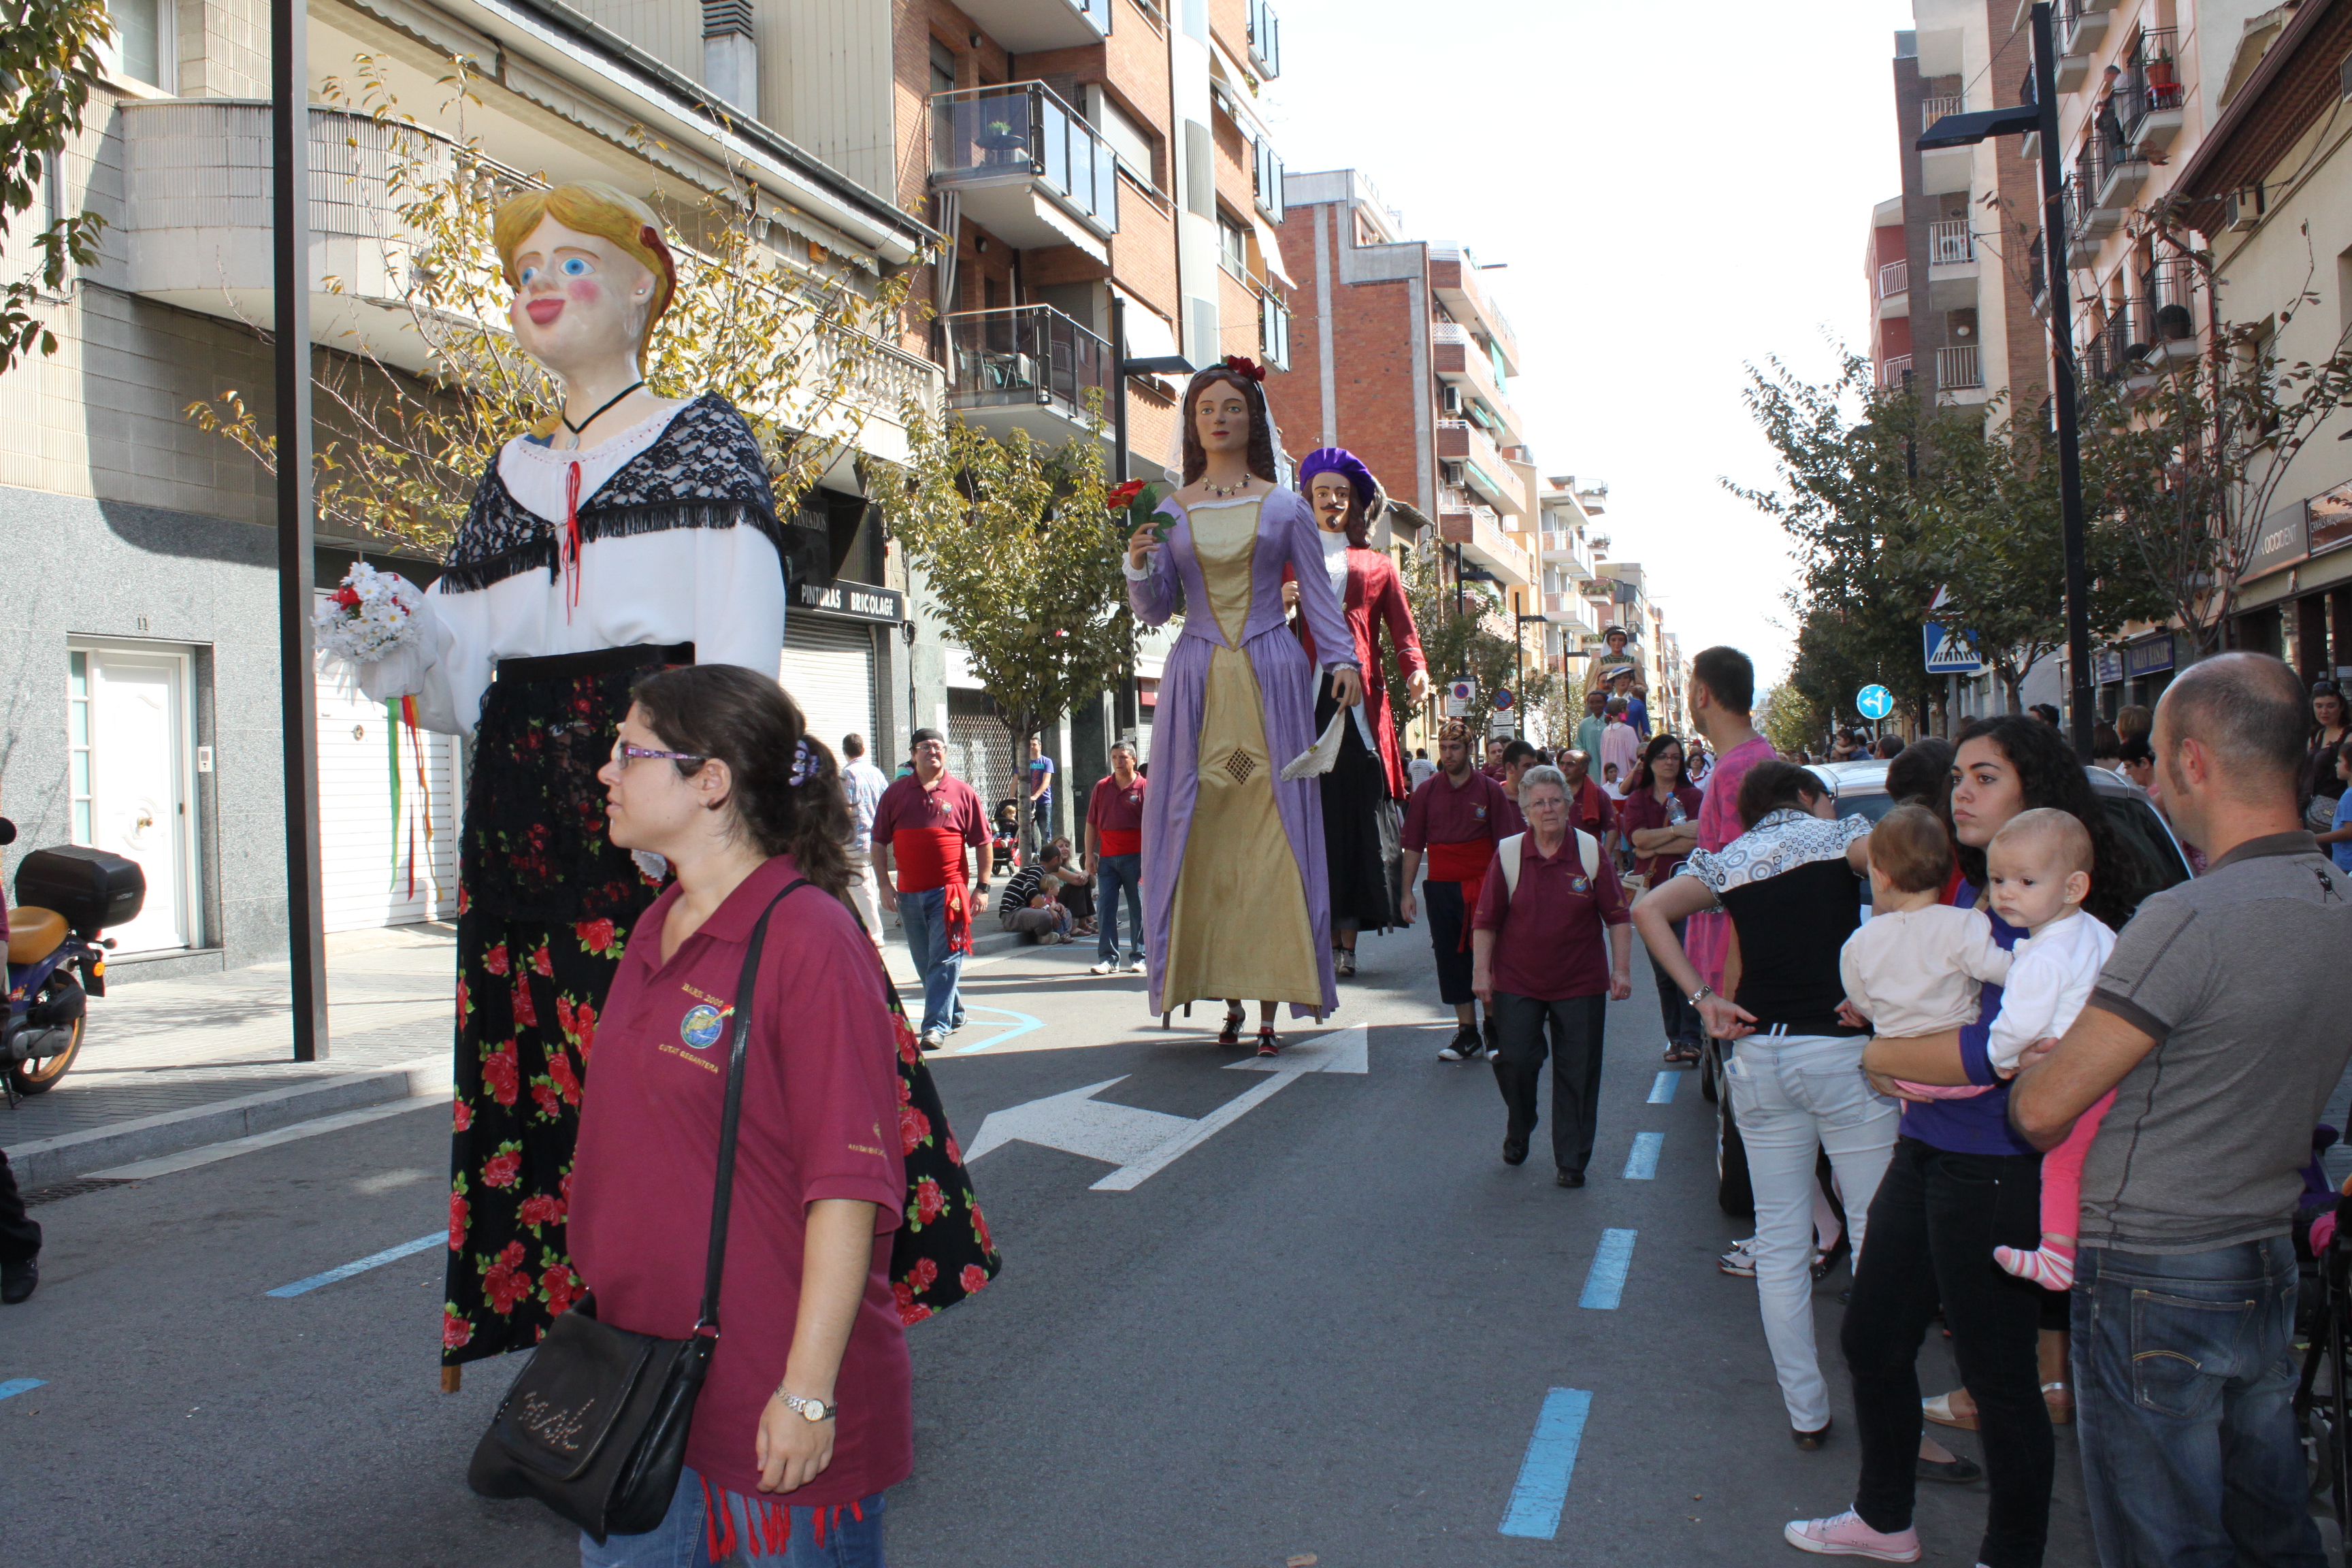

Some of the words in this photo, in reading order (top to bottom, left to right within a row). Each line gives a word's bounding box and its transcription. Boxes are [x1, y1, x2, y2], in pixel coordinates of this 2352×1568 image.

[2264, 523, 2297, 554] OCCIDENT
[801, 584, 841, 609] PINTURAS
[851, 592, 894, 617] BRICOLAGE
[137, 614, 149, 631] 11
[704, 994, 724, 1007] 2000
[680, 1051, 719, 1074] GEGANTERA
